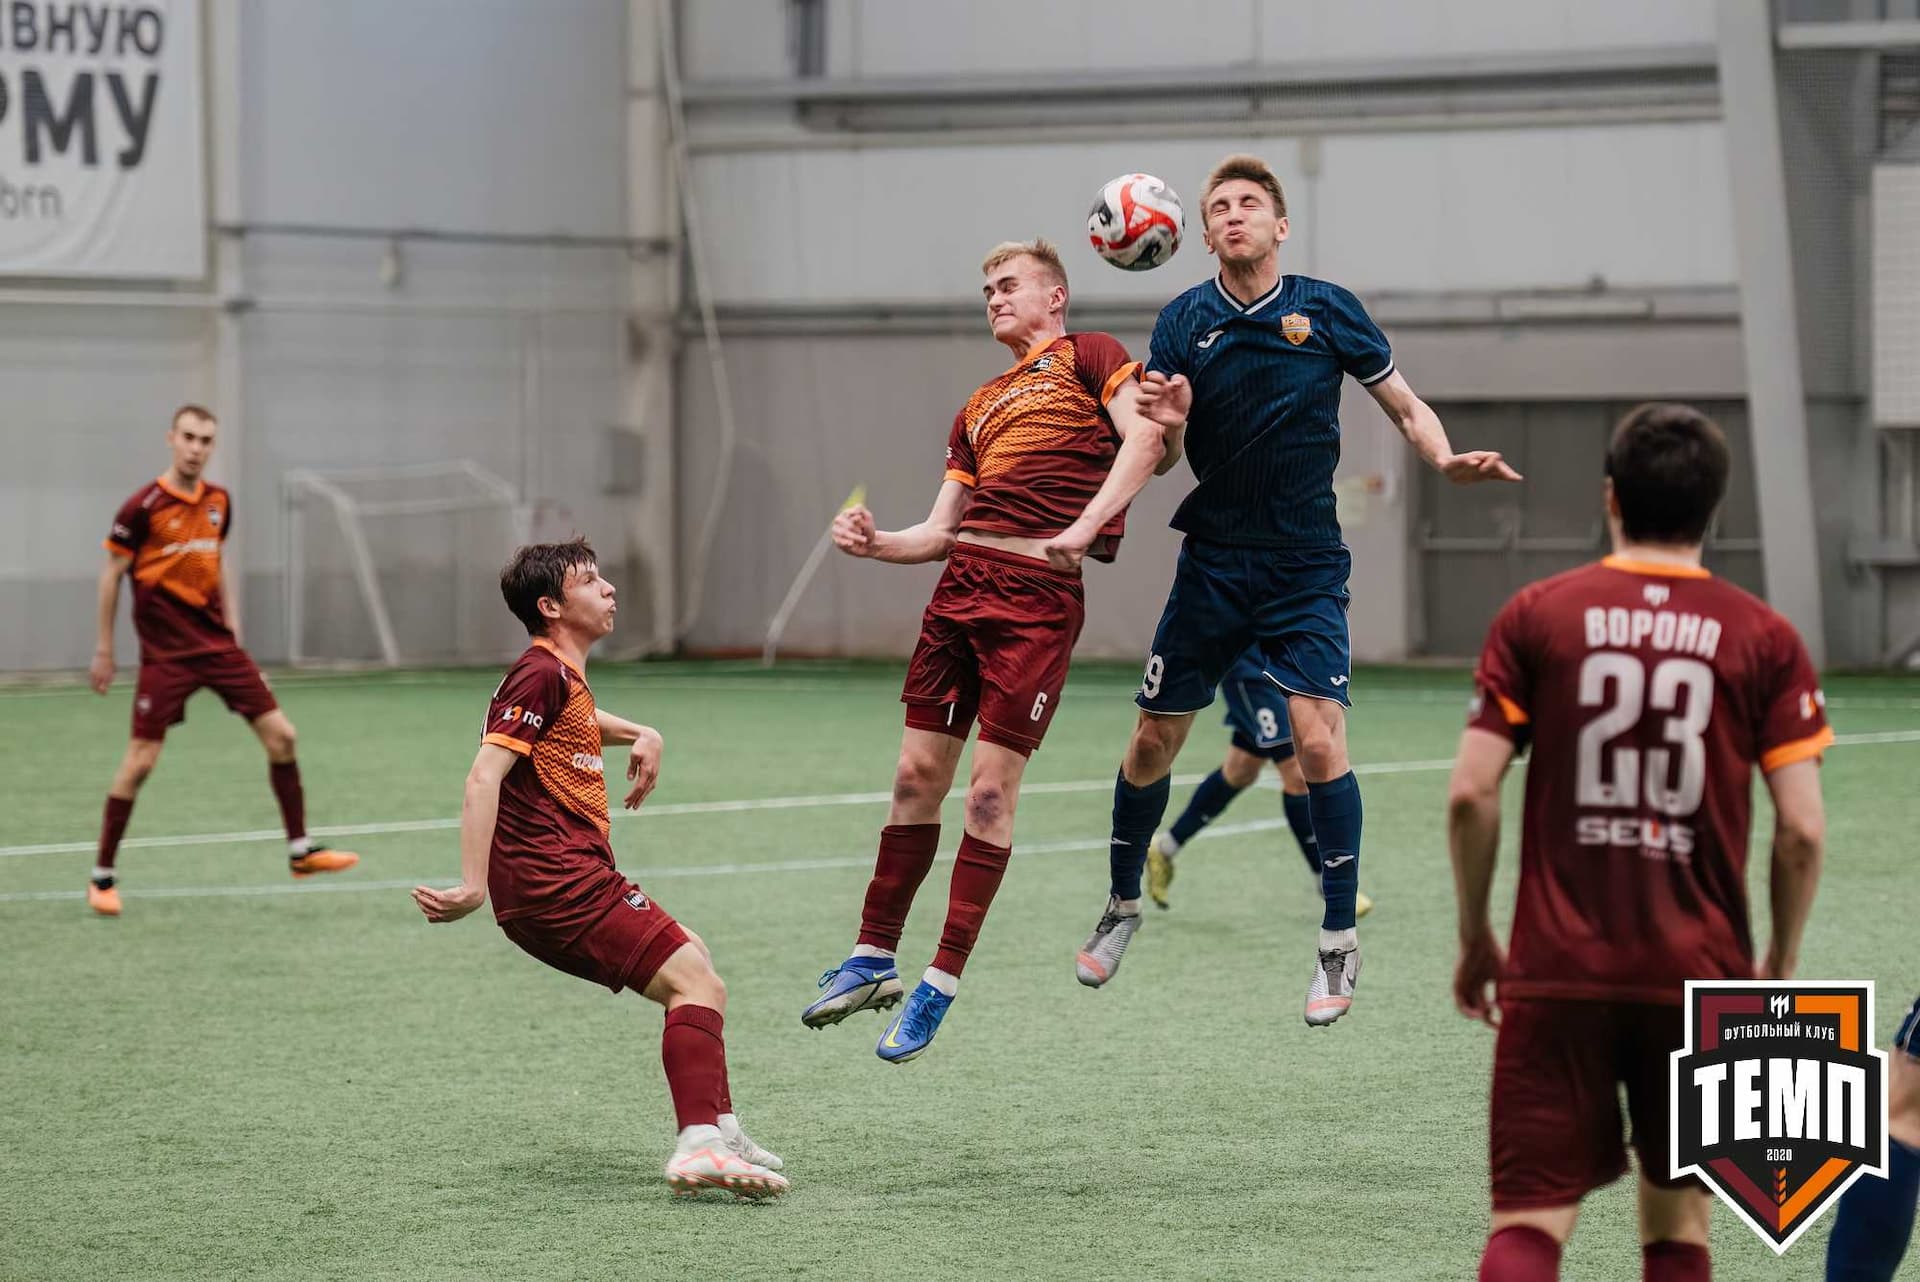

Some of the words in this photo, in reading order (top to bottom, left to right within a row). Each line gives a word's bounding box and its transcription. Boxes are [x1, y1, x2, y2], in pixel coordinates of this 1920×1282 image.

[0, 1, 163, 56] ВНУЮ
[0, 70, 159, 168] МУ
[1030, 691, 1048, 722] 6
[1256, 707, 1279, 739] 8
[1576, 651, 1715, 816] 23
